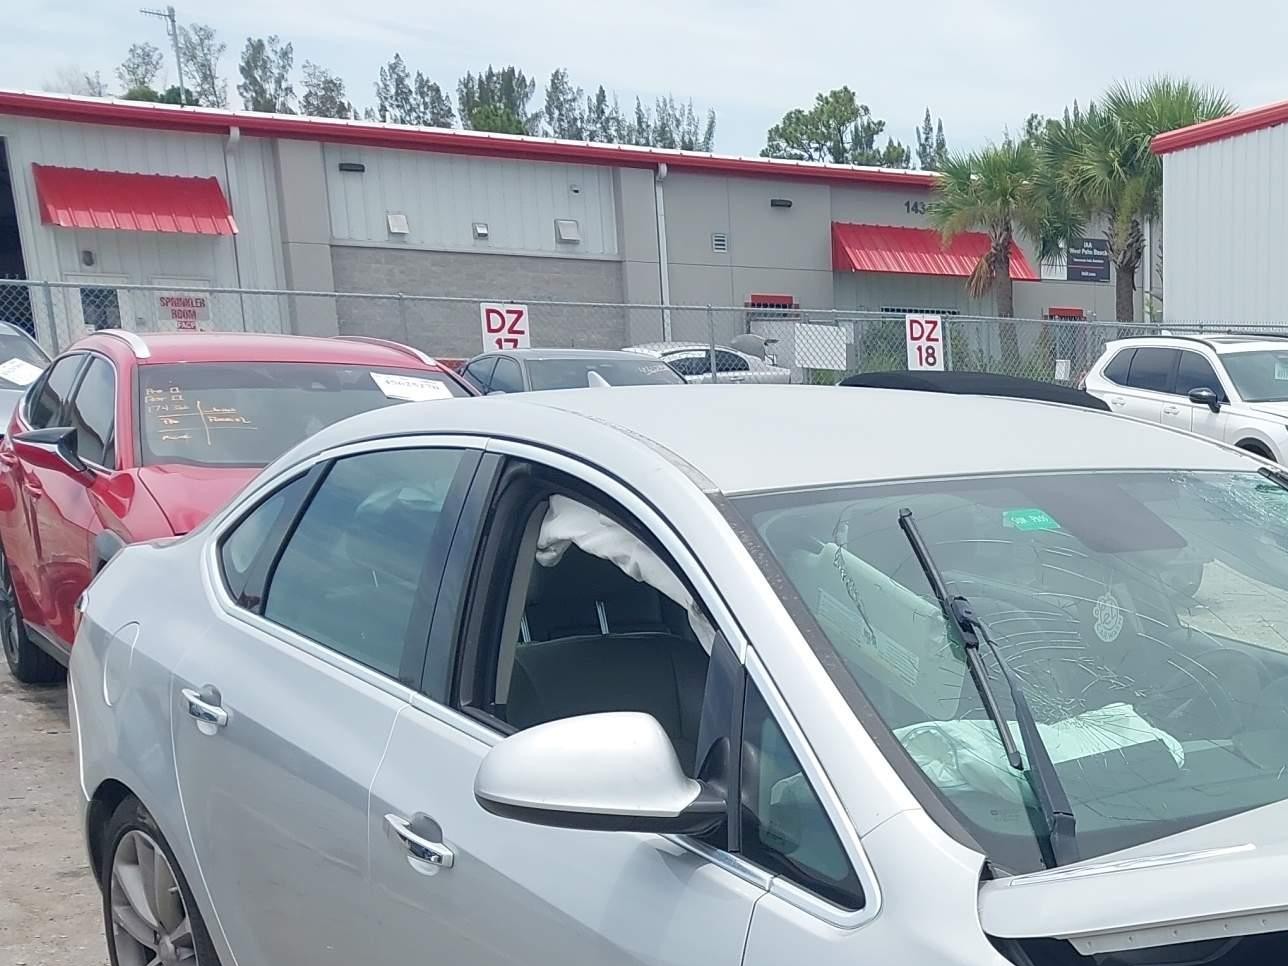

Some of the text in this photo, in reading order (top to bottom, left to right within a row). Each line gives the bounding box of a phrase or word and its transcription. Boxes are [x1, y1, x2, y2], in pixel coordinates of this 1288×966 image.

[485, 308, 525, 335] DZ
[909, 319, 939, 342] DZ
[916, 344, 937, 367] 18
